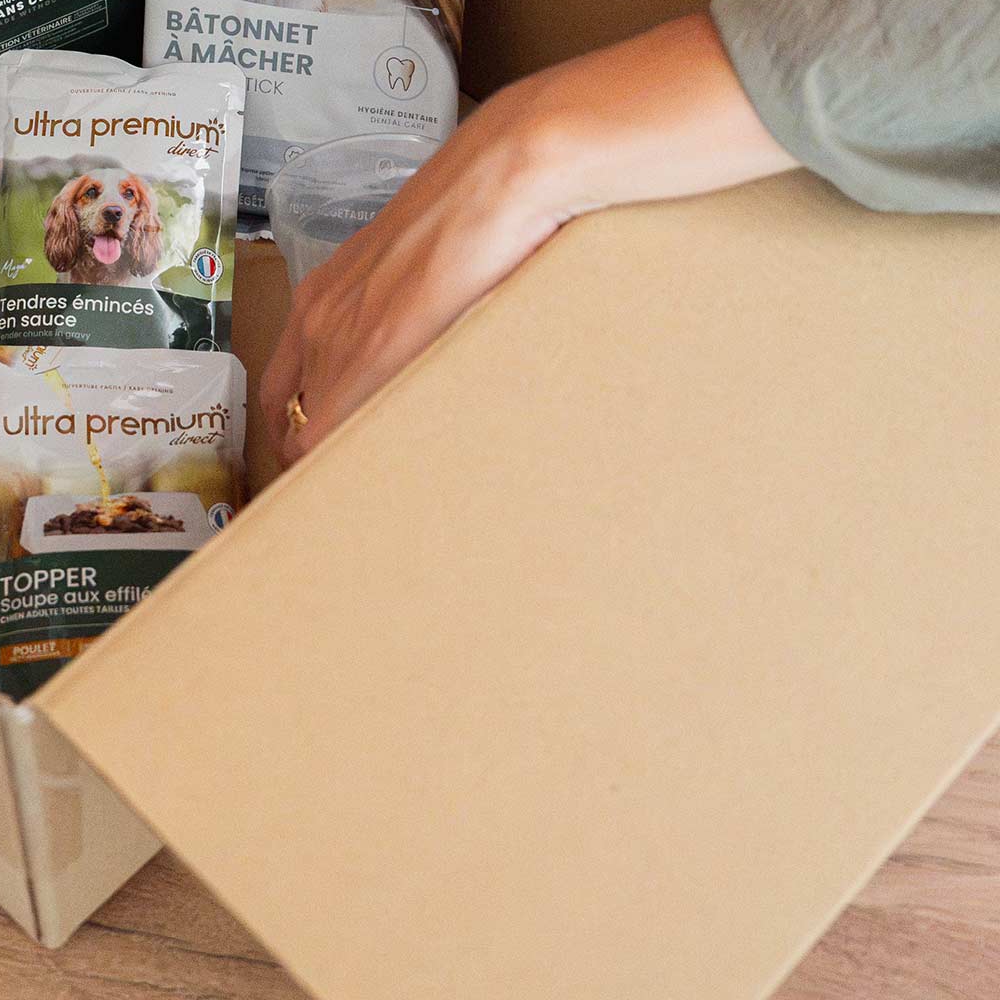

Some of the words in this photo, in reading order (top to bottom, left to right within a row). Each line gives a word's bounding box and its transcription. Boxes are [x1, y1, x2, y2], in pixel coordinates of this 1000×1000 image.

[21, 16, 73, 40] VÉTÉRINAIRE
[166, 6, 318, 45] BÂTONNET
[163, 33, 183, 61] À
[191, 39, 313, 76] MÂCHER
[246, 77, 284, 96] TICK
[370, 116, 401, 127] DENTAL
[397, 111, 438, 124] DENTAIRE
[14, 111, 81, 137] ultra
[90, 116, 220, 147] premium
[167, 142, 219, 159] direct
[0, 294, 67, 313] Tendres
[72, 294, 154, 315] émincés
[21, 313, 77, 328] sauce
[22, 328, 51, 337] chunks
[55, 328, 64, 336] in
[65, 331, 91, 341] gravy
[2, 405, 75, 437] ultra
[86, 410, 226, 445] premium
[169, 432, 224, 447] direct
[0, 566, 97, 597] TOPPER
[0, 592, 58, 613] Soupe
[64, 590, 100, 605] aux
[105, 585, 152, 603] effilé
[0, 612, 25, 624] CHIEN
[26, 607, 58, 619] ADULTE
[61, 605, 95, 616] TOUTES
[96, 604, 130, 614] TAILLES
[13, 642, 56, 656] POULET
